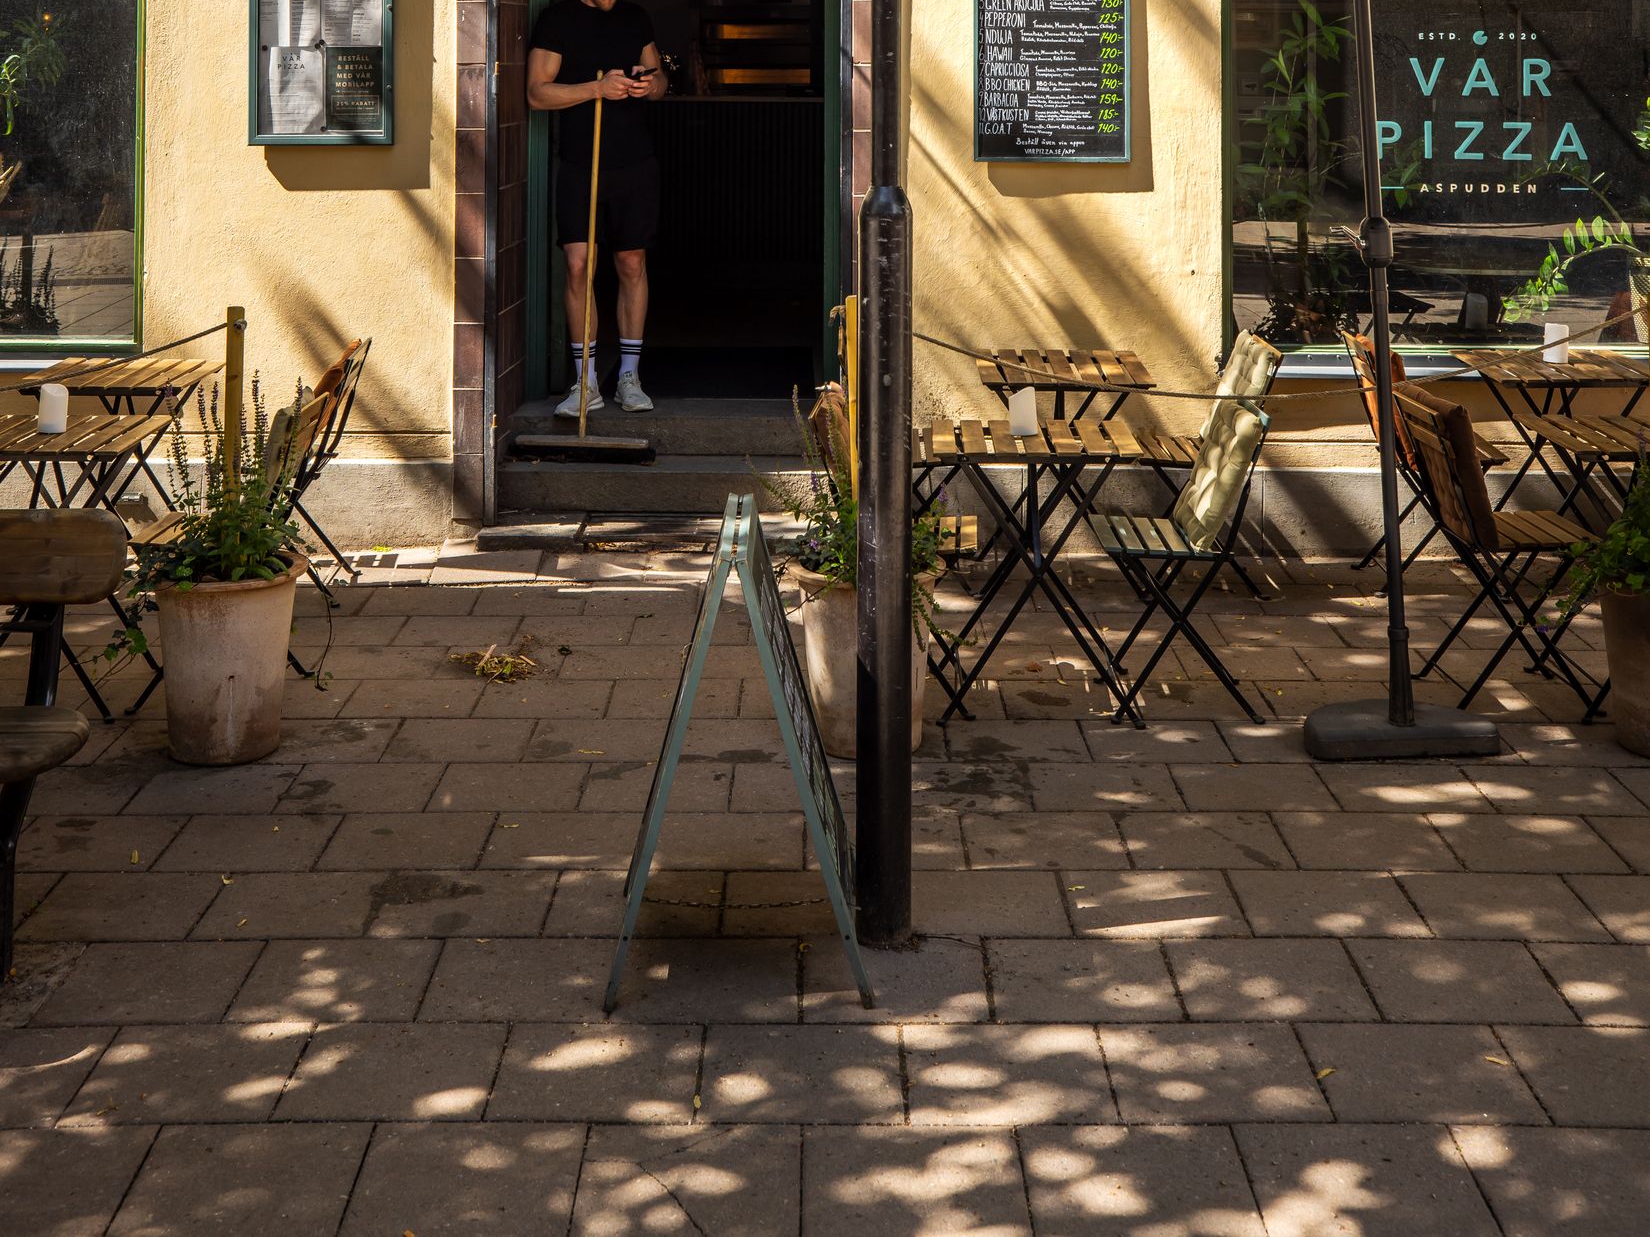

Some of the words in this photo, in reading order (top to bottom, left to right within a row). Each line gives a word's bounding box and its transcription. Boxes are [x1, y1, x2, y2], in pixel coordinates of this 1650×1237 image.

[985, 12, 1026, 28] PEPPERONI
[985, 28, 1013, 44] NDUJA
[1418, 32, 1461, 41] ESTD.
[1498, 32, 1537, 41] 2020
[987, 45, 1013, 61] HAWAII
[985, 62, 1030, 77] CAPRICCIOSA
[1409, 30, 1552, 96] VÅR
[1003, 78, 1030, 91] CHICKEN
[984, 91, 1019, 107] BARBACOA
[1376, 120, 1589, 161] PIZZA
[1419, 183, 1537, 194] ASPUDDEN
